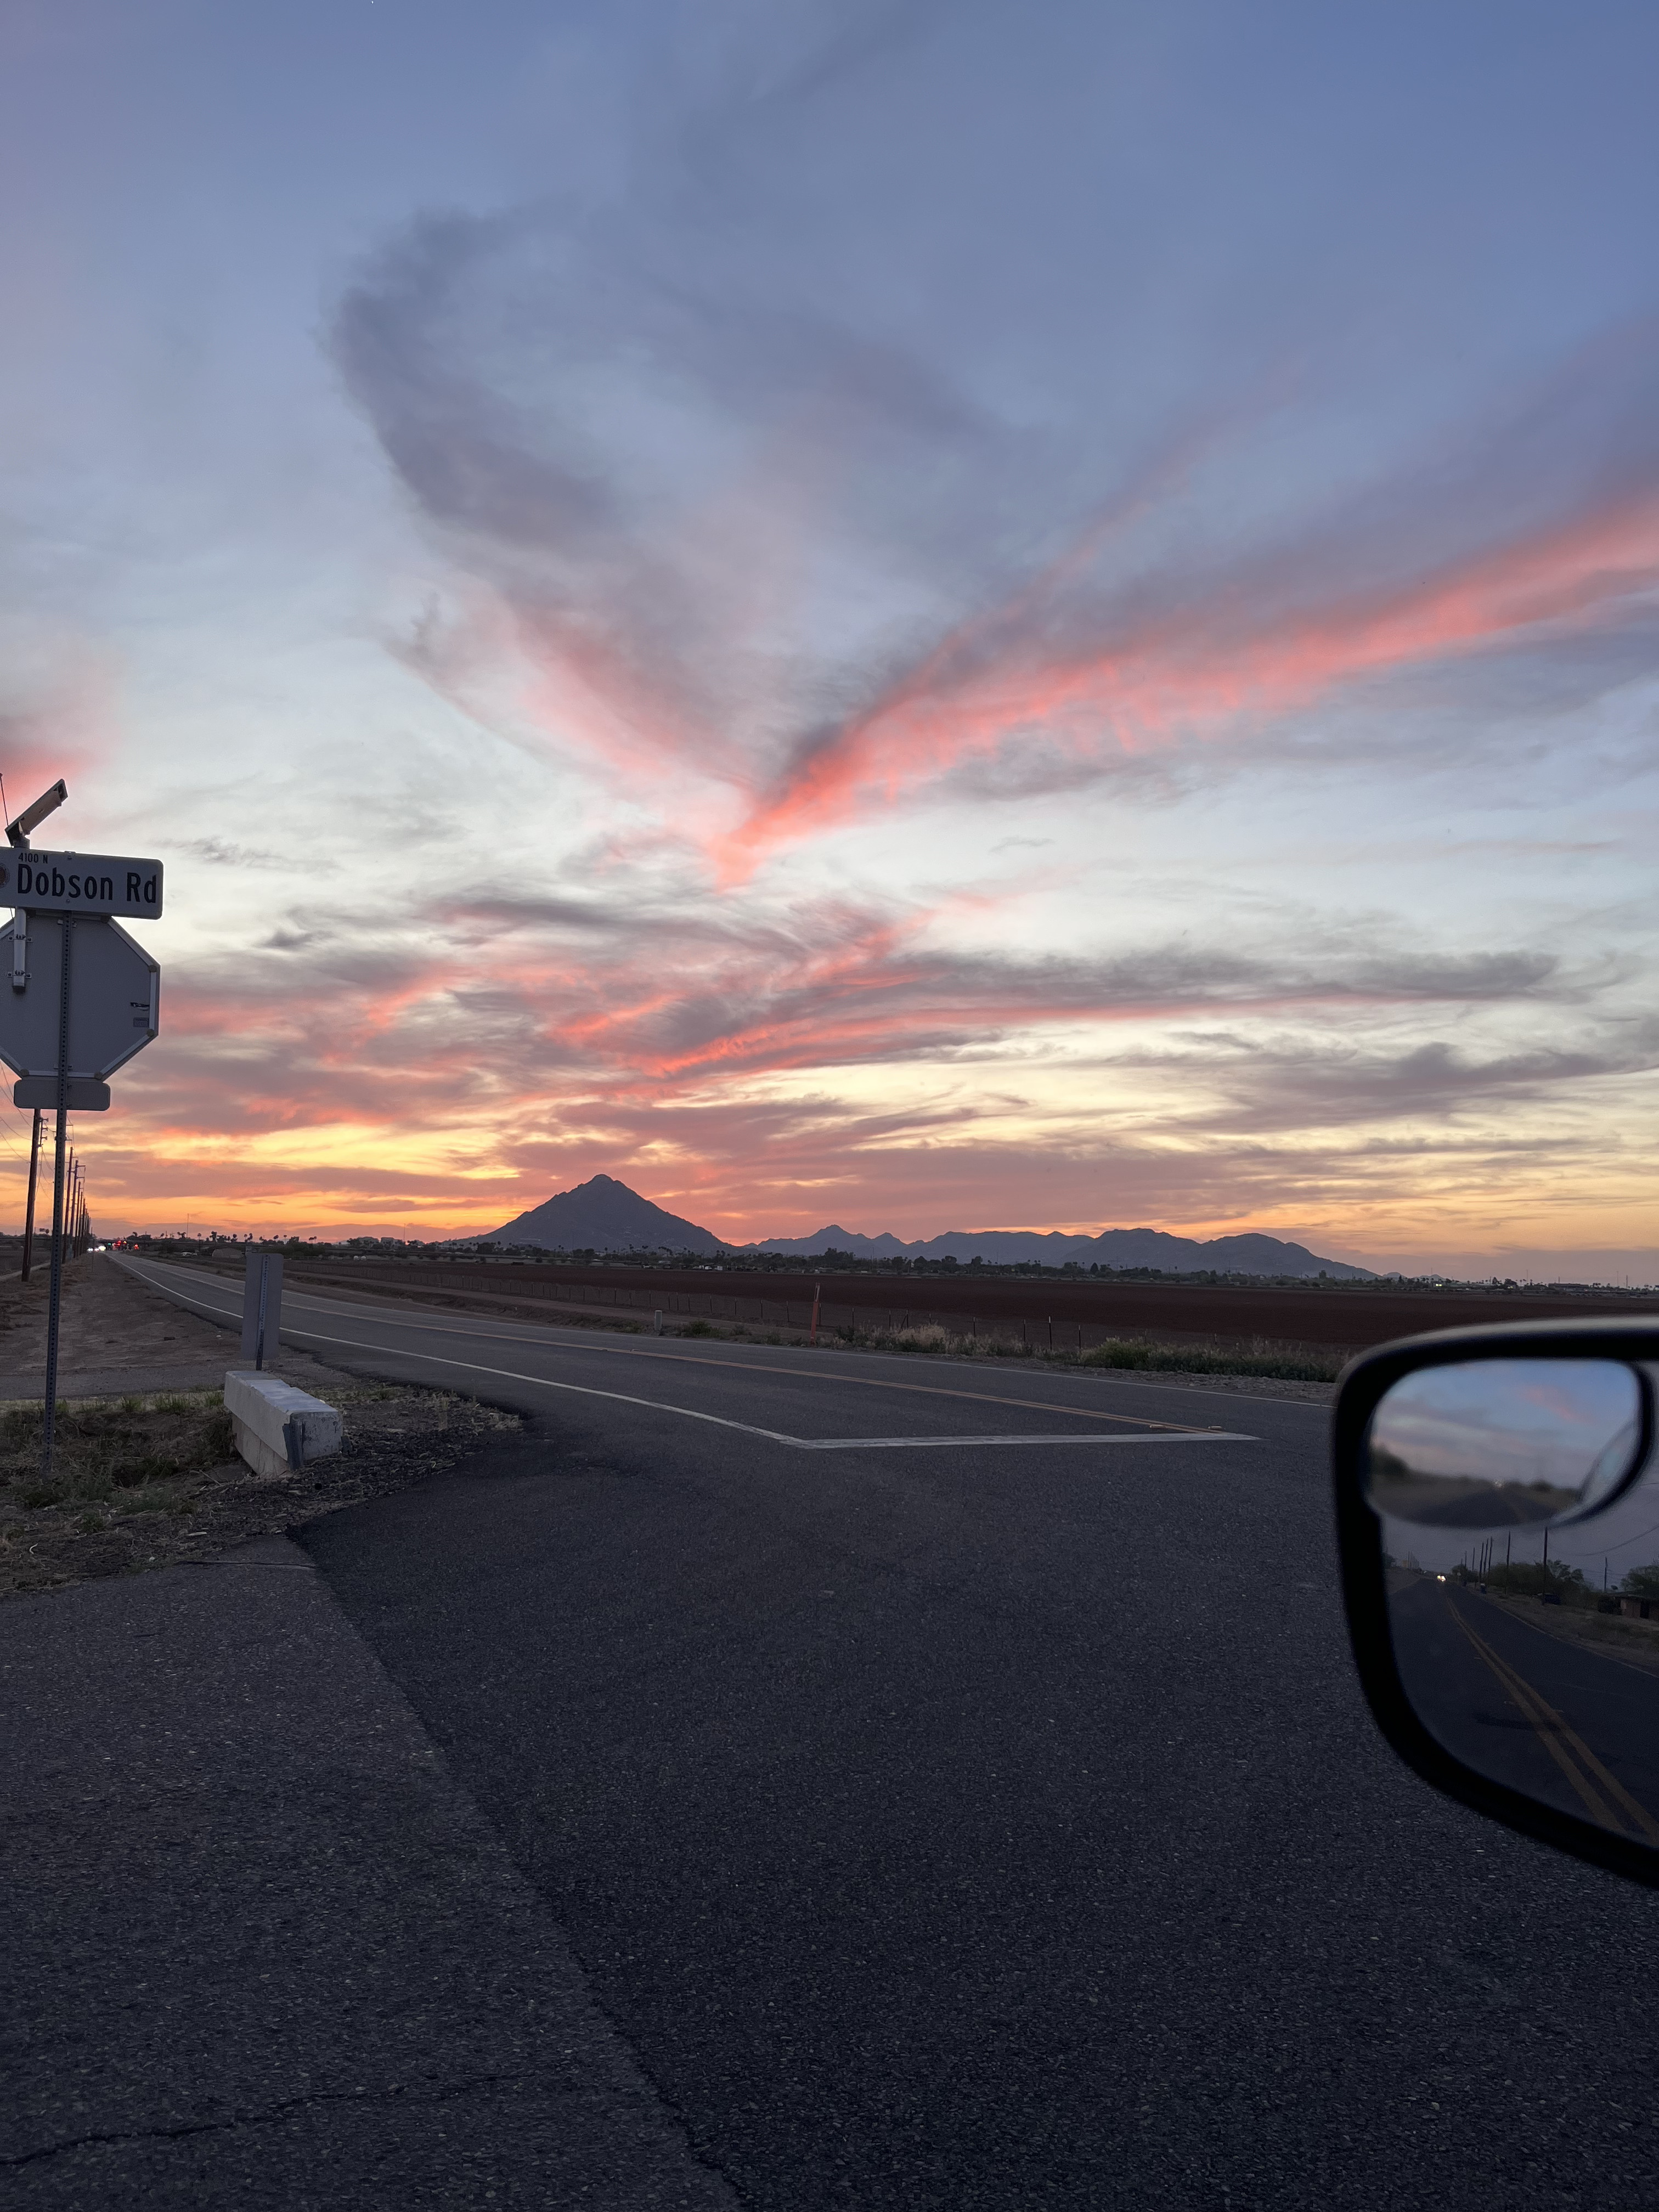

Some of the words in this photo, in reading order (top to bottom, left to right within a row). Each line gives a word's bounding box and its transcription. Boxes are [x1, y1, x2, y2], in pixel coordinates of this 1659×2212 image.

[18, 853, 39, 863] 4100
[43, 854, 48, 864] N
[18, 864, 113, 900] Dobson
[127, 872, 156, 903] Rd
